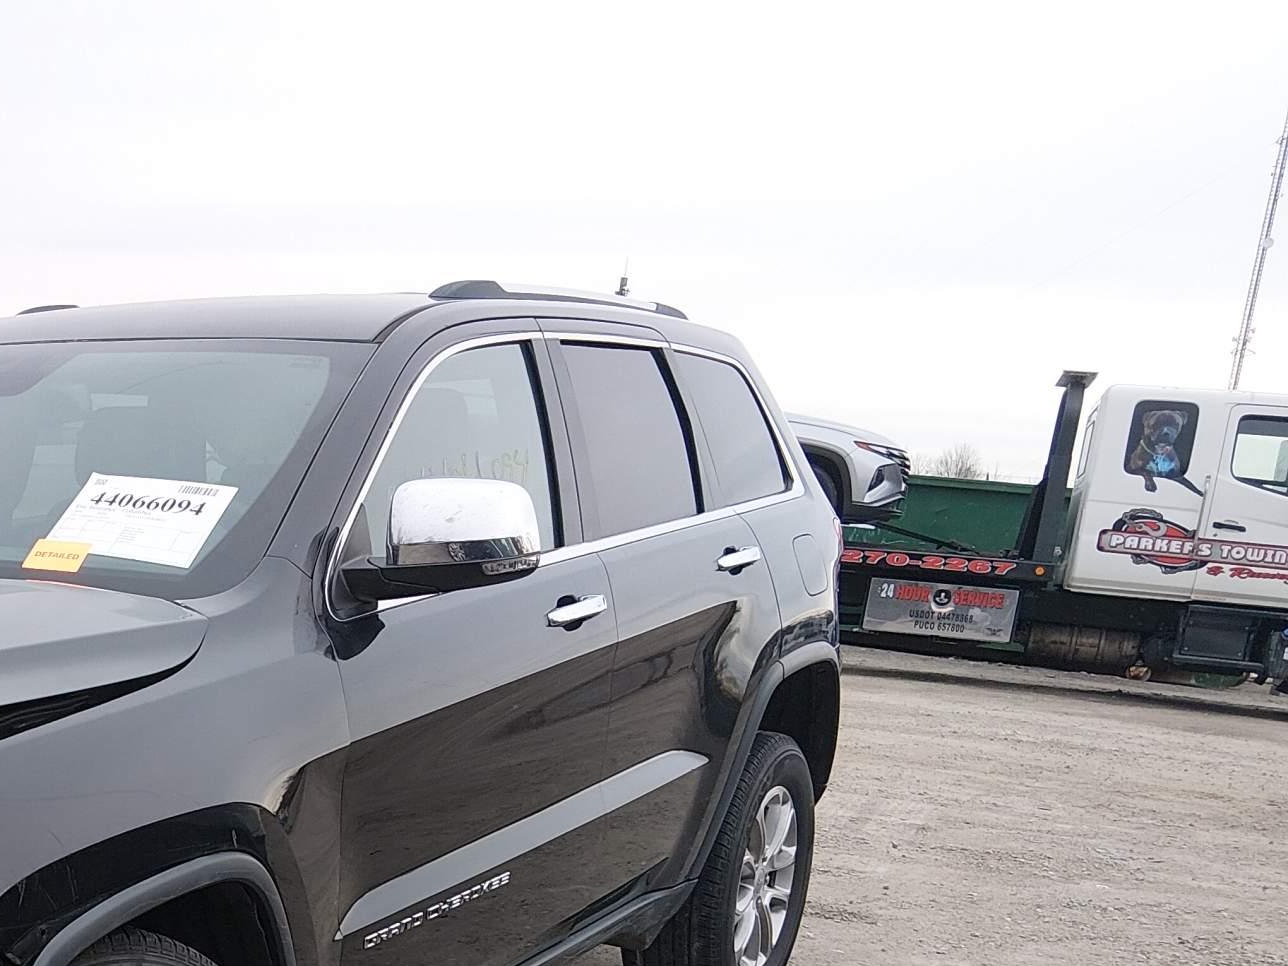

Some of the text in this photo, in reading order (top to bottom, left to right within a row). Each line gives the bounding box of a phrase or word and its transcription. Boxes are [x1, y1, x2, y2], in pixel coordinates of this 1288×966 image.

[91, 492, 207, 516] 44066094
[34, 550, 80, 560] DETAILED
[840, 549, 1017, 575] 270-2267
[1220, 544, 1288, 564] TOWIN
[880, 582, 1006, 609] 24 HOUR SERVICE
[909, 609, 935, 620] USDOT
[363, 871, 511, 950] GRAND CHEROKEE
